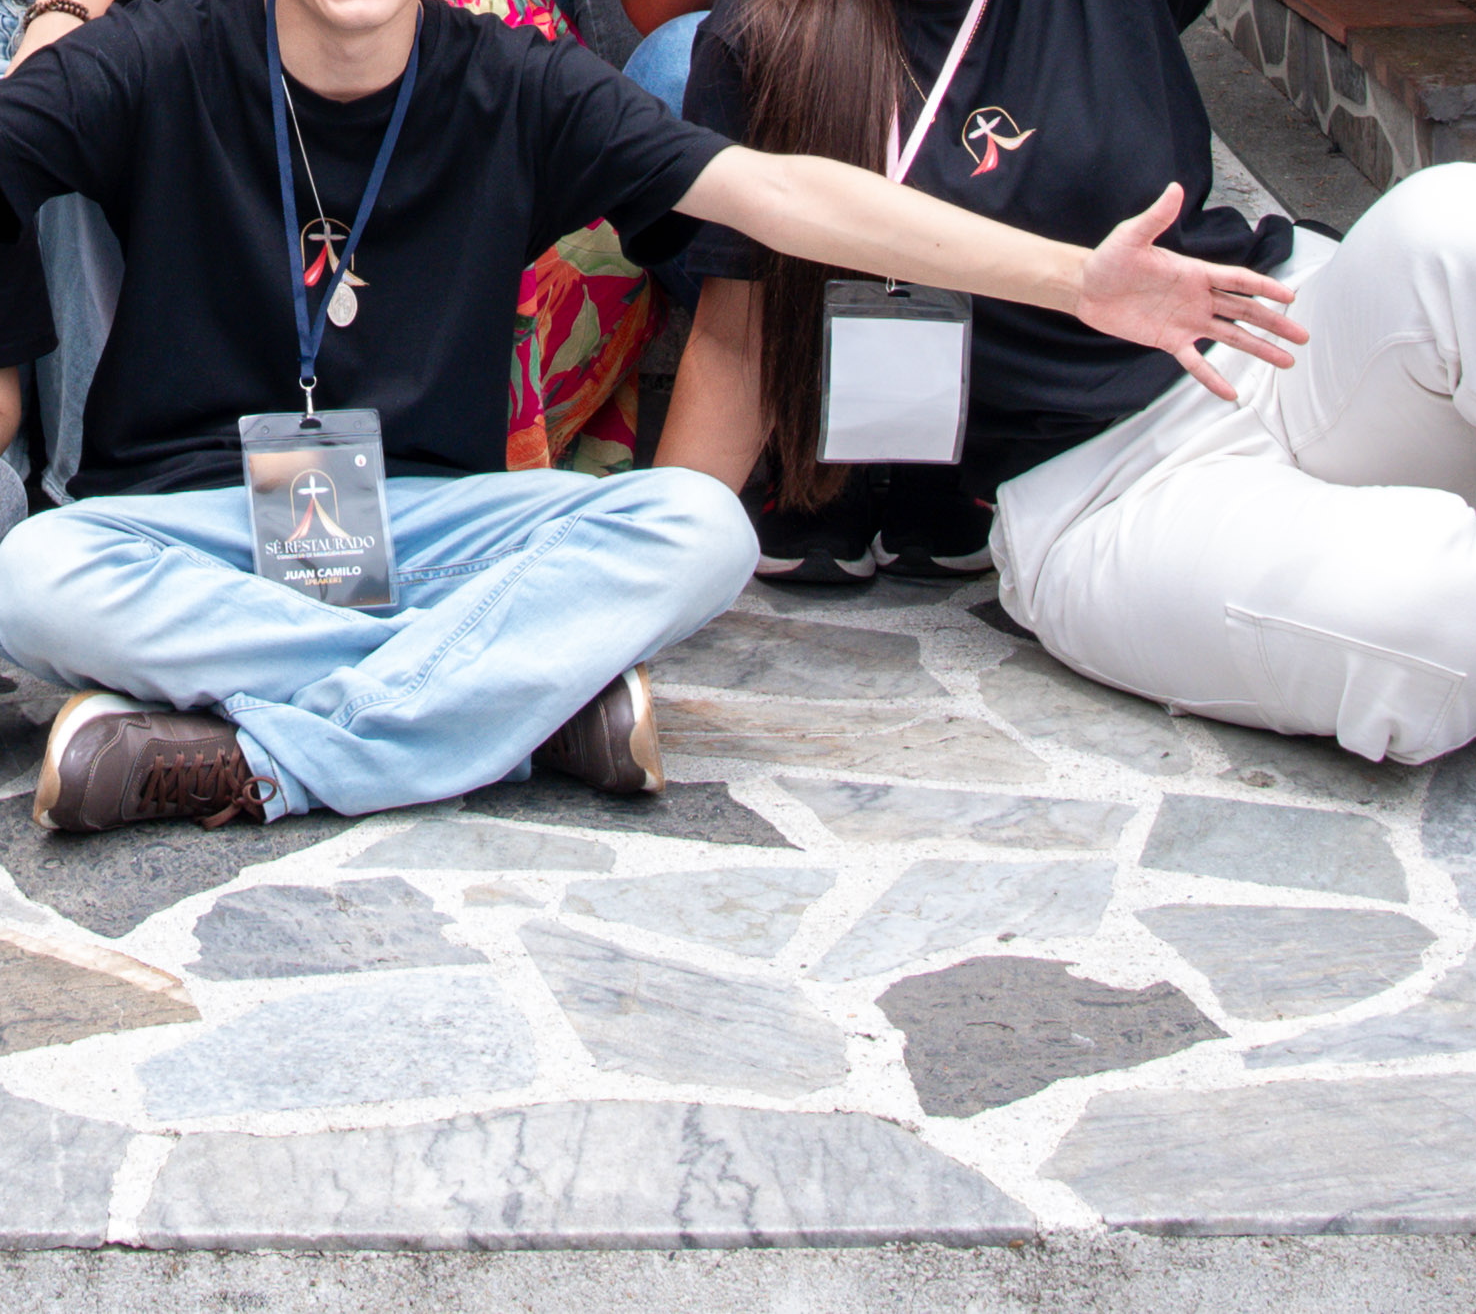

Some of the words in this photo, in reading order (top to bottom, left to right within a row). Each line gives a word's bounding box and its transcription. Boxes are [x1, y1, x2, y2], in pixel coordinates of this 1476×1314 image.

[284, 535, 376, 554] RESTAURADO
[283, 569, 315, 581] JUAN
[316, 565, 362, 579] CAMILO
